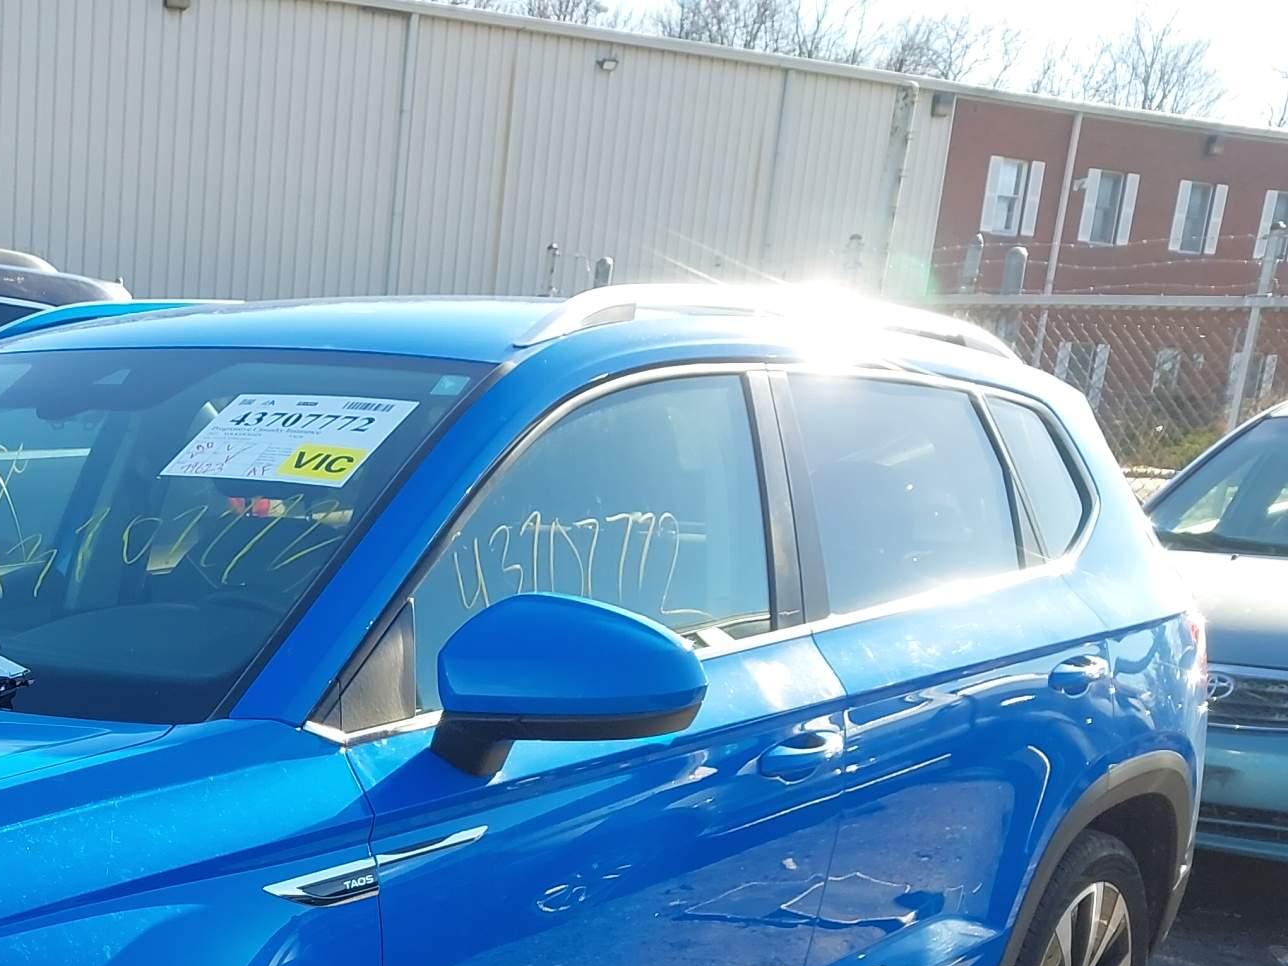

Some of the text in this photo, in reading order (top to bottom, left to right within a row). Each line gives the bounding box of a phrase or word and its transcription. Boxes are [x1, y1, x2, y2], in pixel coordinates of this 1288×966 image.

[230, 411, 375, 432] 43707772
[294, 451, 354, 473] VIC
[343, 874, 374, 890] TAOS
